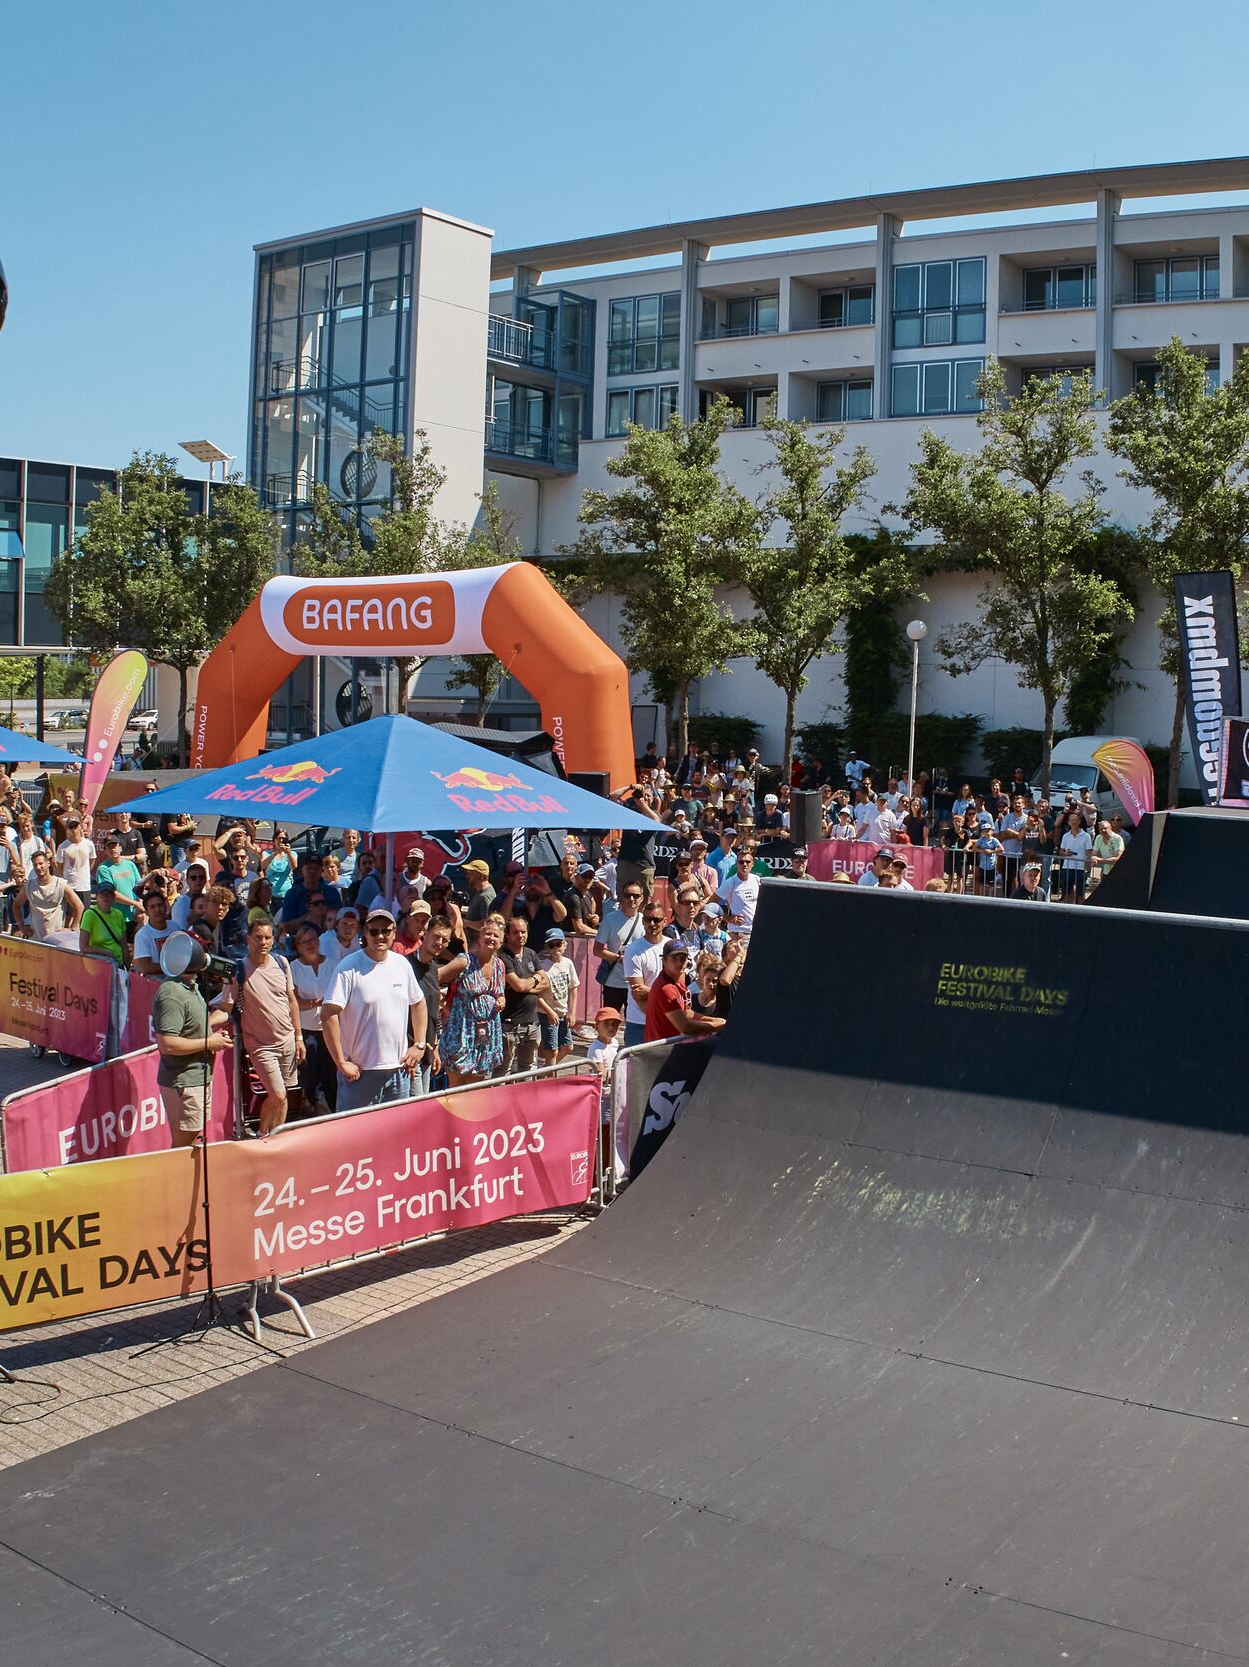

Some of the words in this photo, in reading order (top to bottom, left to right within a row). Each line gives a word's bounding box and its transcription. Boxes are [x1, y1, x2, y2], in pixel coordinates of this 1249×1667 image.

[302, 595, 433, 632] BAFANG
[103, 668, 141, 737] Eurobike.com
[1183, 594, 1229, 798] eedombmx
[195, 705, 208, 751] POWER
[205, 784, 265, 801] Red
[253, 786, 319, 806] Bull
[447, 794, 512, 814] Red
[509, 795, 569, 814] Bull
[832, 859, 915, 879] EUROE
[9, 972, 60, 1003] Festival
[64, 985, 99, 1018] Days
[937, 980, 1015, 1001] FESTIVAL
[1019, 986, 1069, 1006] DAYS
[940, 963, 1028, 984] EUROBIKE
[58, 1094, 167, 1165] EUROBI
[394, 1137, 461, 1181] Juni
[473, 1121, 545, 1167] 2023
[253, 1210, 366, 1260] Messe
[377, 1166, 525, 1229] Frankfurt
[99, 1239, 211, 1290] DAYS
